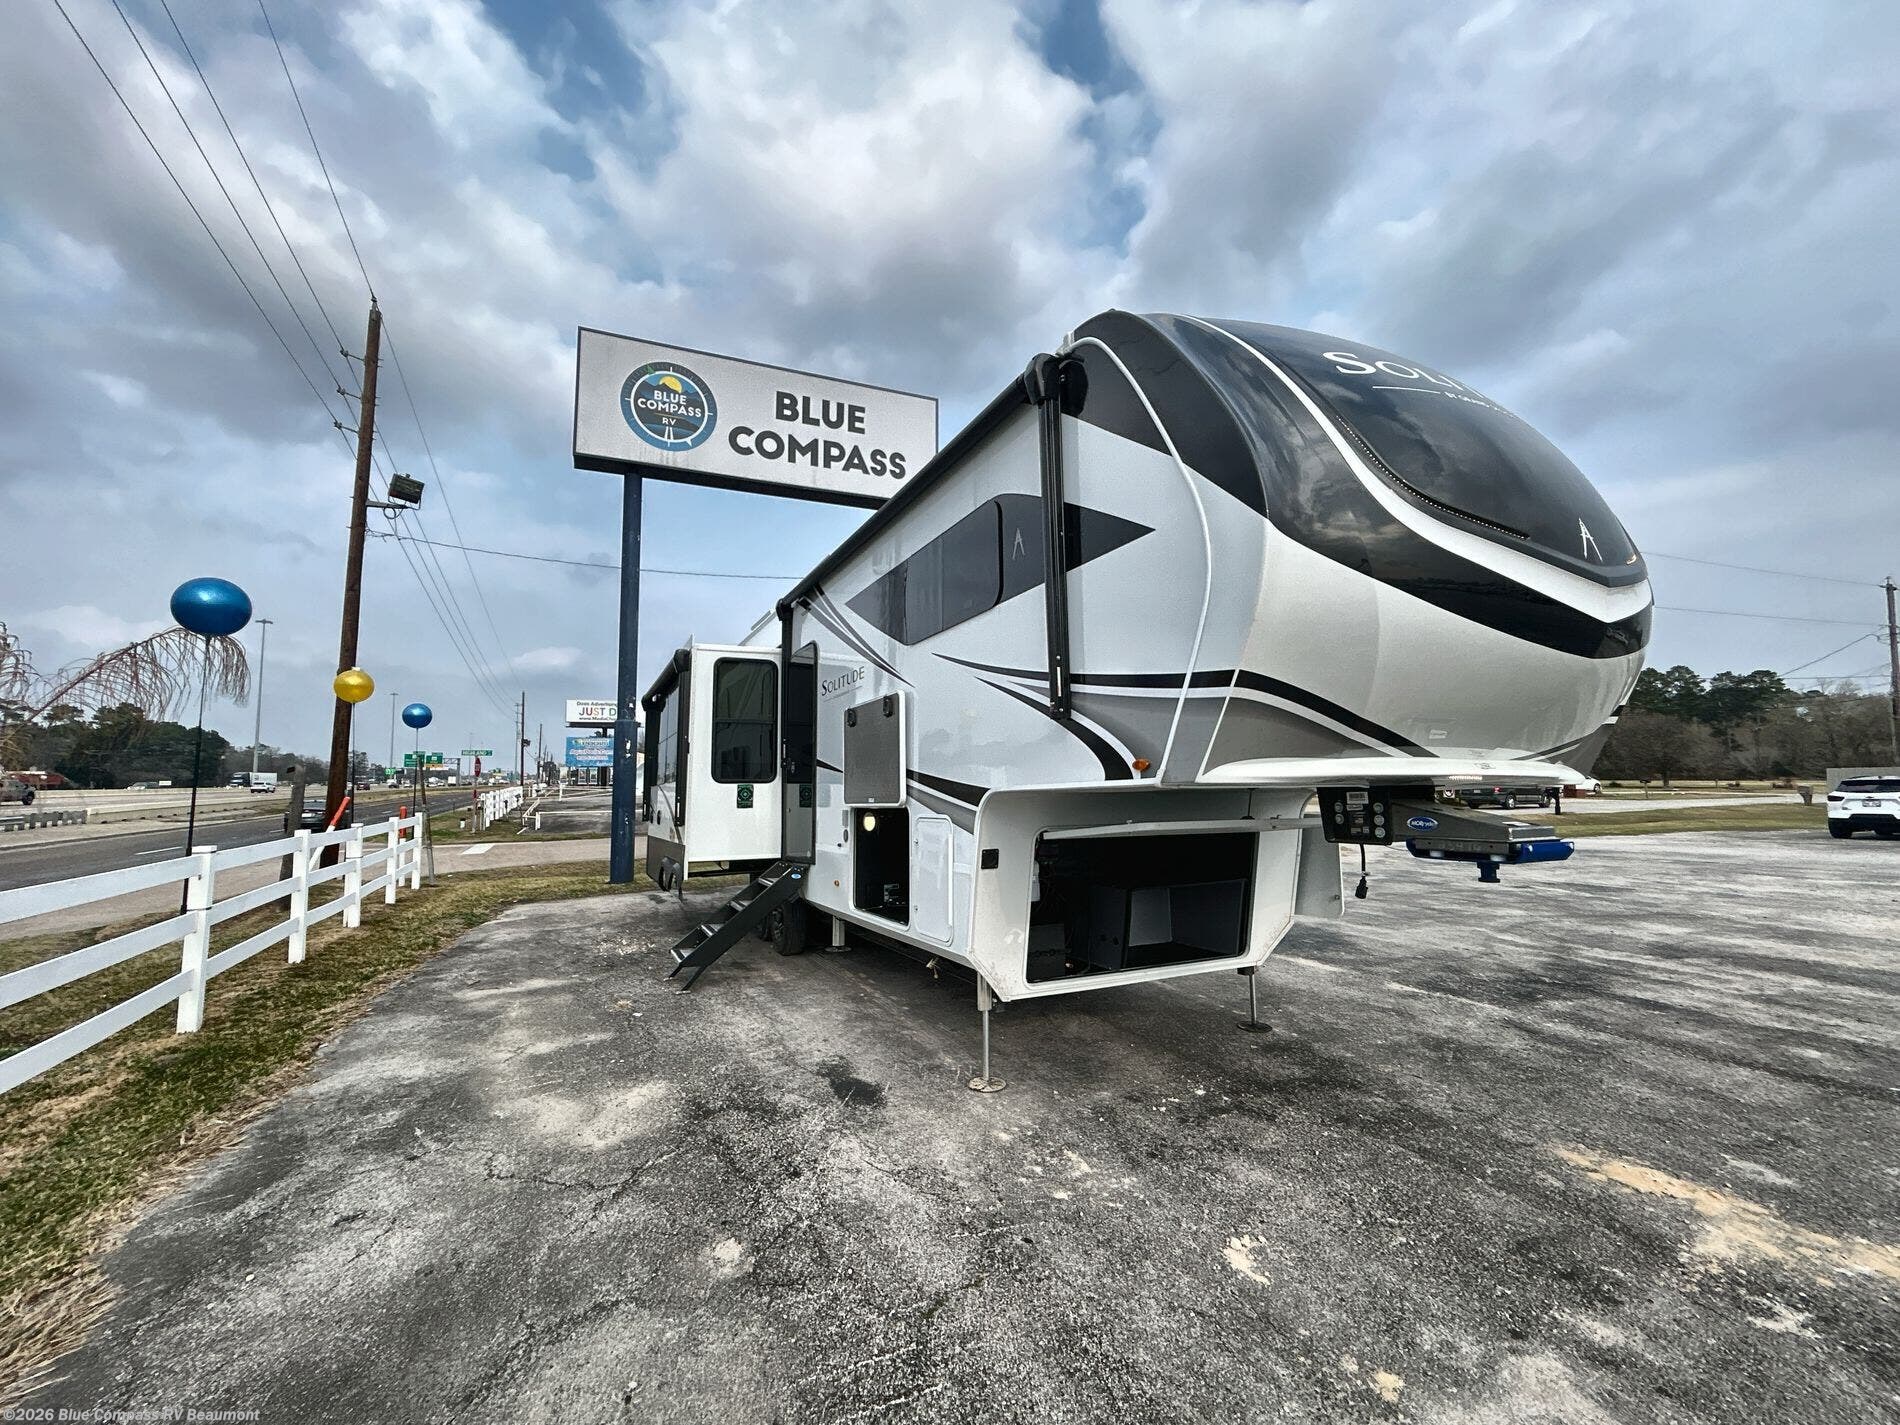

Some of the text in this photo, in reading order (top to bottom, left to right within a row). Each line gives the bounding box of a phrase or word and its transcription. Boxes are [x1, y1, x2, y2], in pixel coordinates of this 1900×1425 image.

[653, 390, 687, 405] BLUE
[637, 398, 702, 418] COMPASS
[775, 390, 866, 434] BLUE
[662, 417, 677, 426] RV
[728, 425, 907, 479] COMPASS
[821, 666, 865, 696] SOLITUDE
[579, 707, 606, 716] JUST
